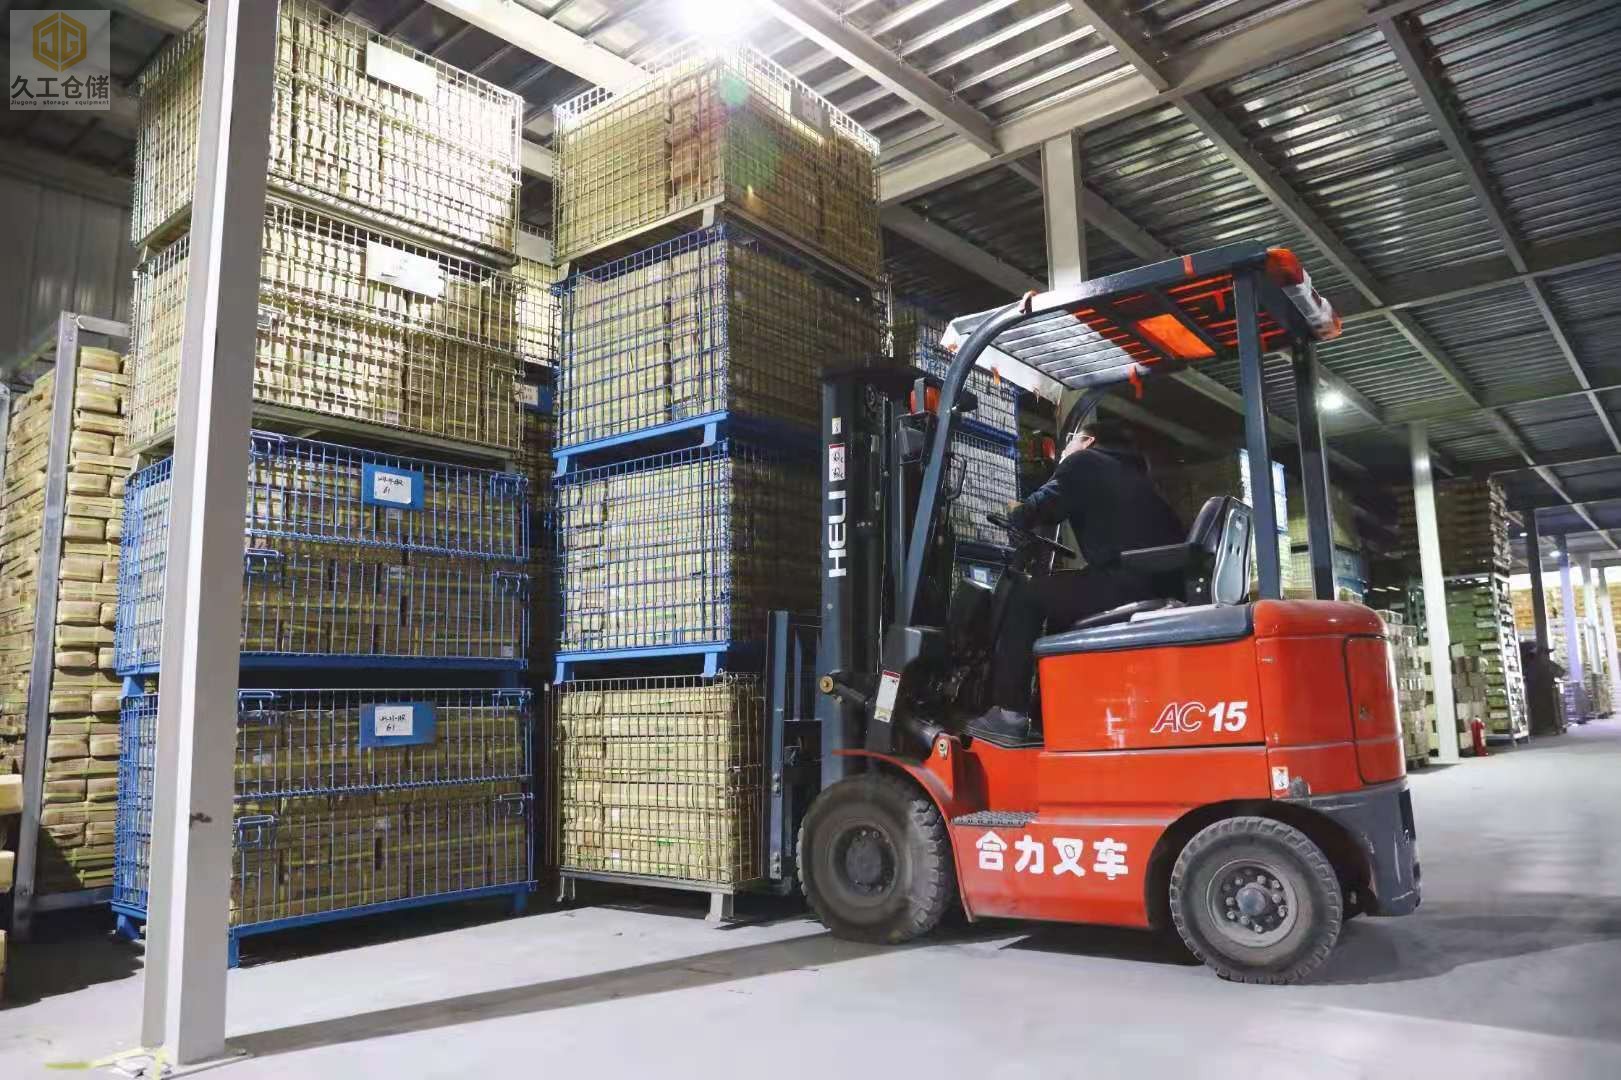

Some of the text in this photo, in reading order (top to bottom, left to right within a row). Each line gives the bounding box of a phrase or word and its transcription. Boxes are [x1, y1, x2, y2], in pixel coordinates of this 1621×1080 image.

[828, 490, 847, 578] HELI
[1150, 701, 1248, 733] AC 15
[975, 831, 1129, 880] 合力叉车
